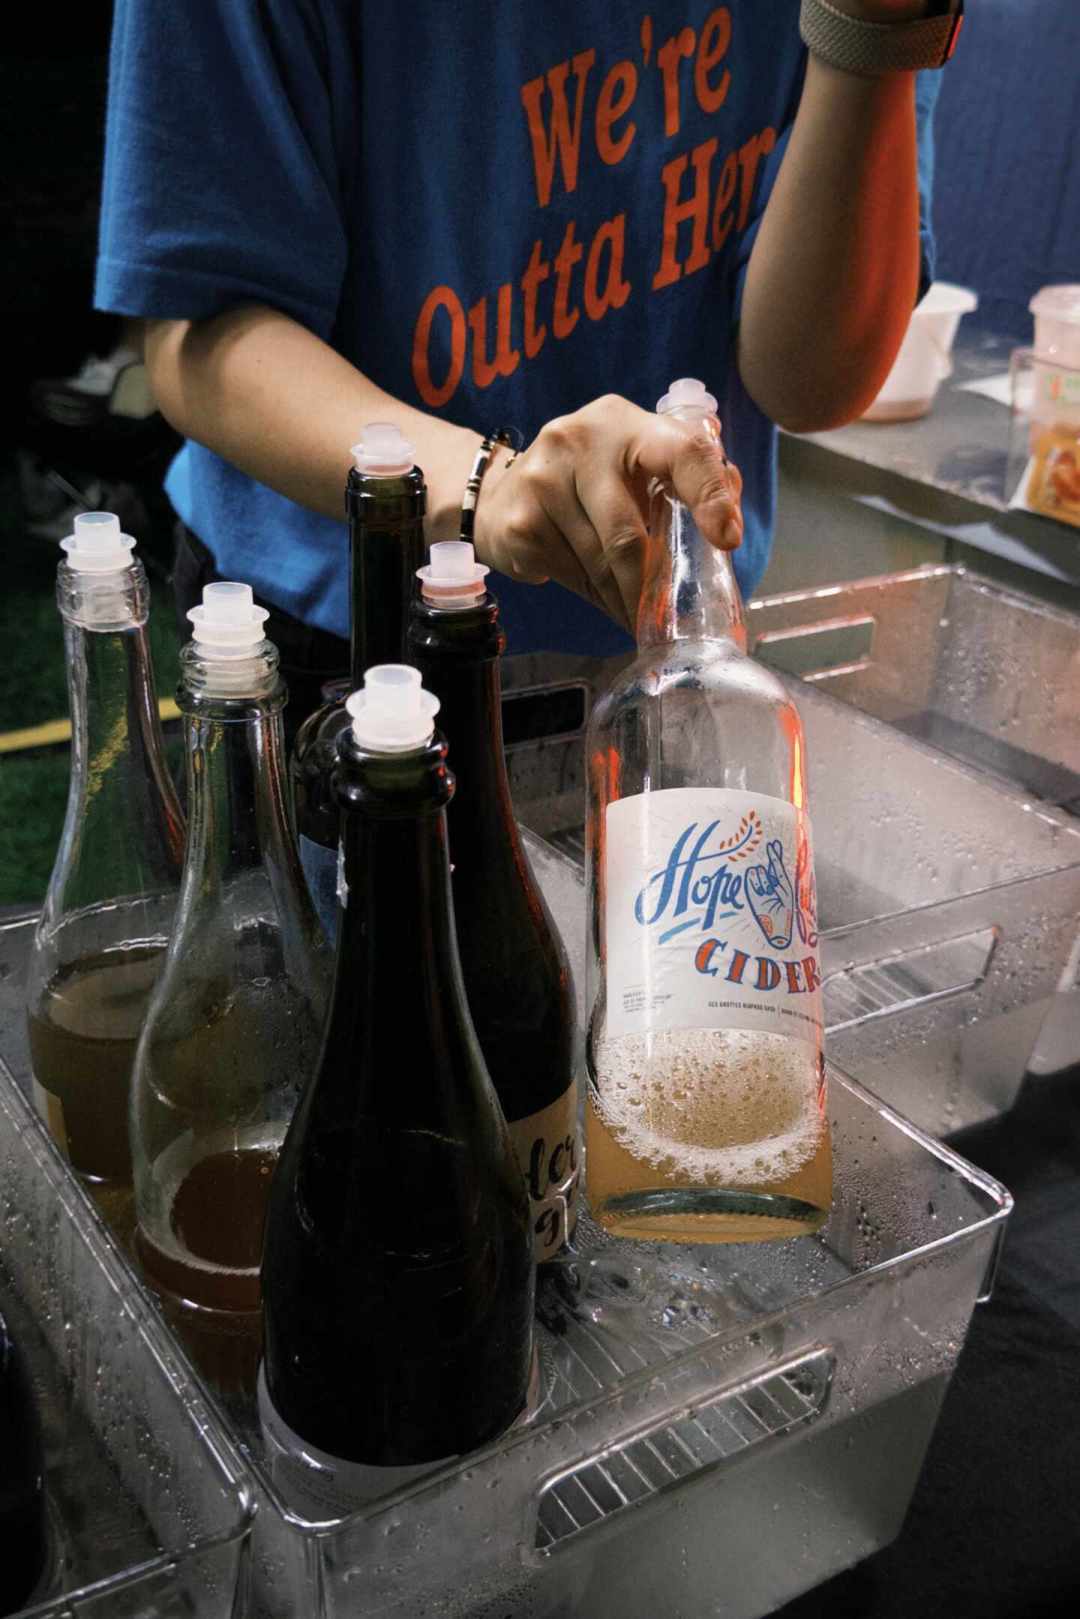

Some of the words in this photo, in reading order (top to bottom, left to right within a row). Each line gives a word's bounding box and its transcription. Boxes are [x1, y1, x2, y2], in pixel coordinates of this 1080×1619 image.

[520, 7, 732, 208] We're
[411, 213, 631, 408] Outta
[634, 819, 745, 931] Hope
[694, 937, 822, 995] CIDER
